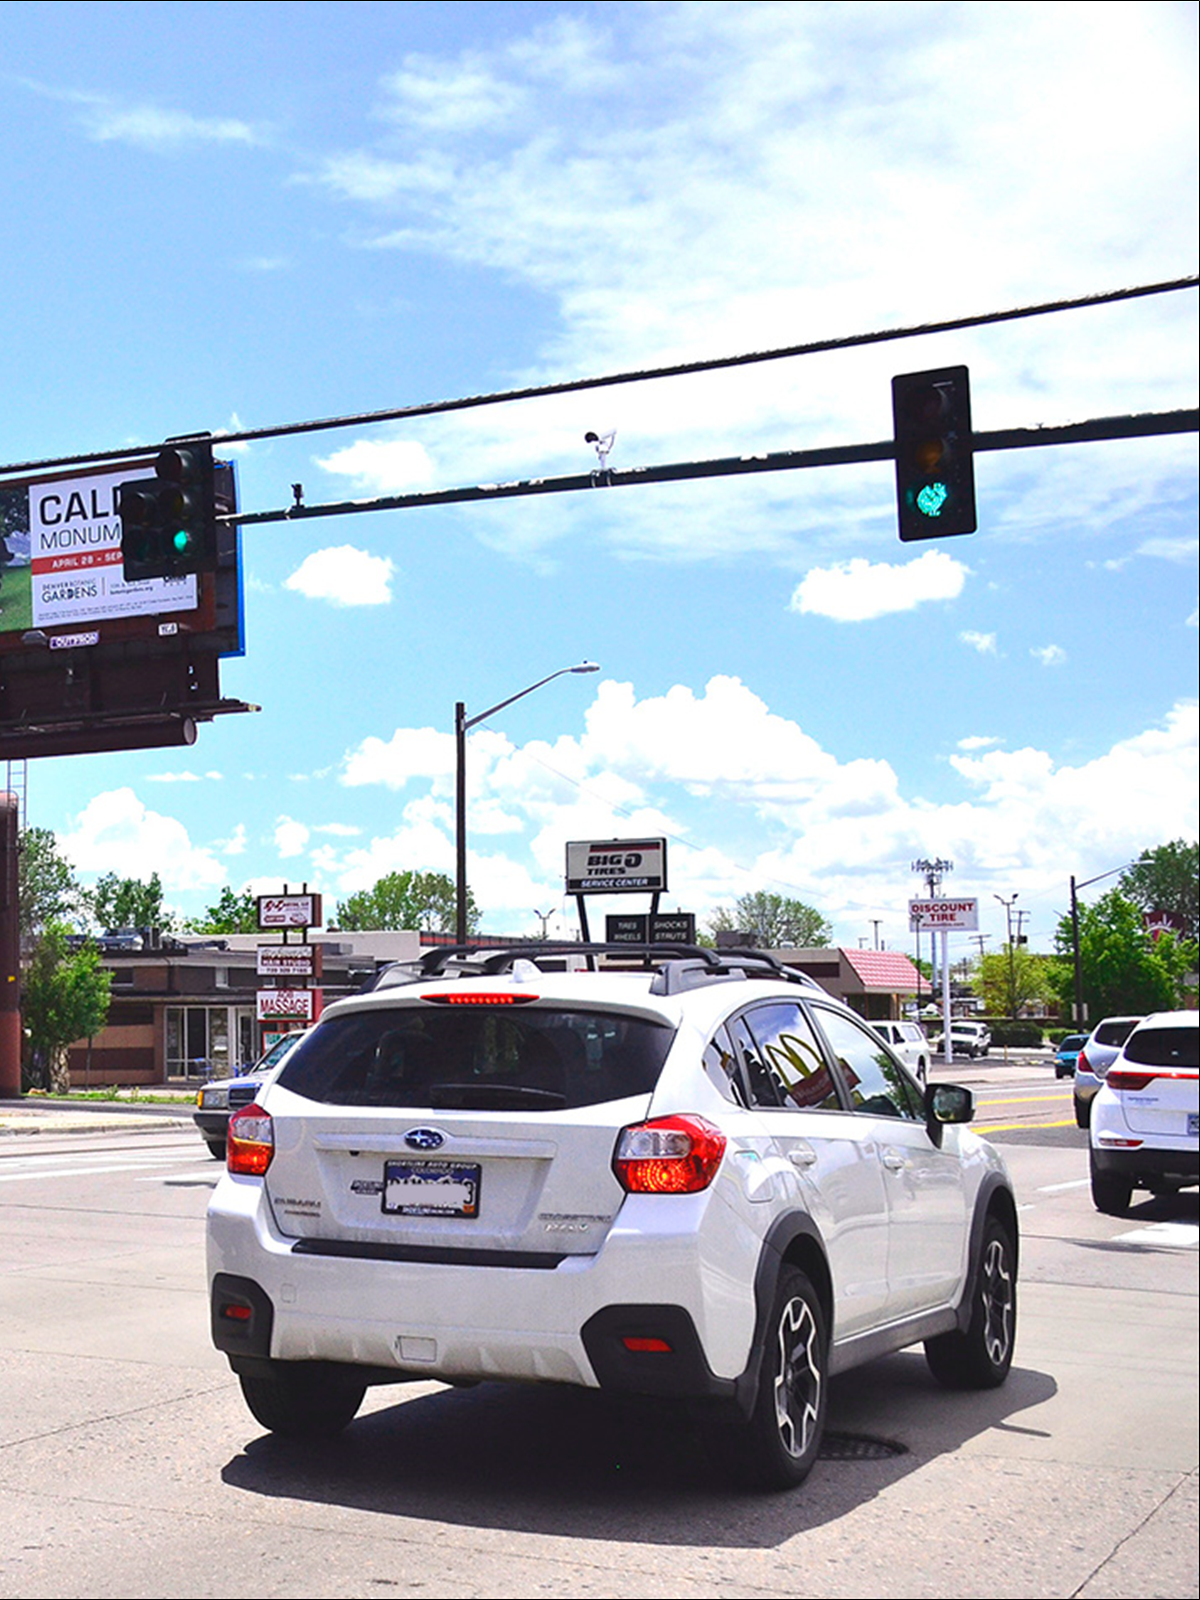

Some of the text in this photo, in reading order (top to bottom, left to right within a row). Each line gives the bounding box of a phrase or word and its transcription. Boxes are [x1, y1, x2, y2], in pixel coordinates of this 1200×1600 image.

[40, 522, 121, 550] MONUM
[52, 558, 79, 569] APRIL
[81, 555, 94, 565] 28
[41, 585, 98, 604] GARDENS
[587, 854, 623, 866] BIG
[587, 867, 626, 876] TIRES
[581, 878, 648, 888] SERVICE CENTER
[911, 902, 974, 914] DISCOUNT
[930, 913, 957, 922] TIRE
[654, 920, 688, 929] SHOCKS
[655, 931, 687, 940] STRUTS
[260, 999, 309, 1014] MASSAGE
